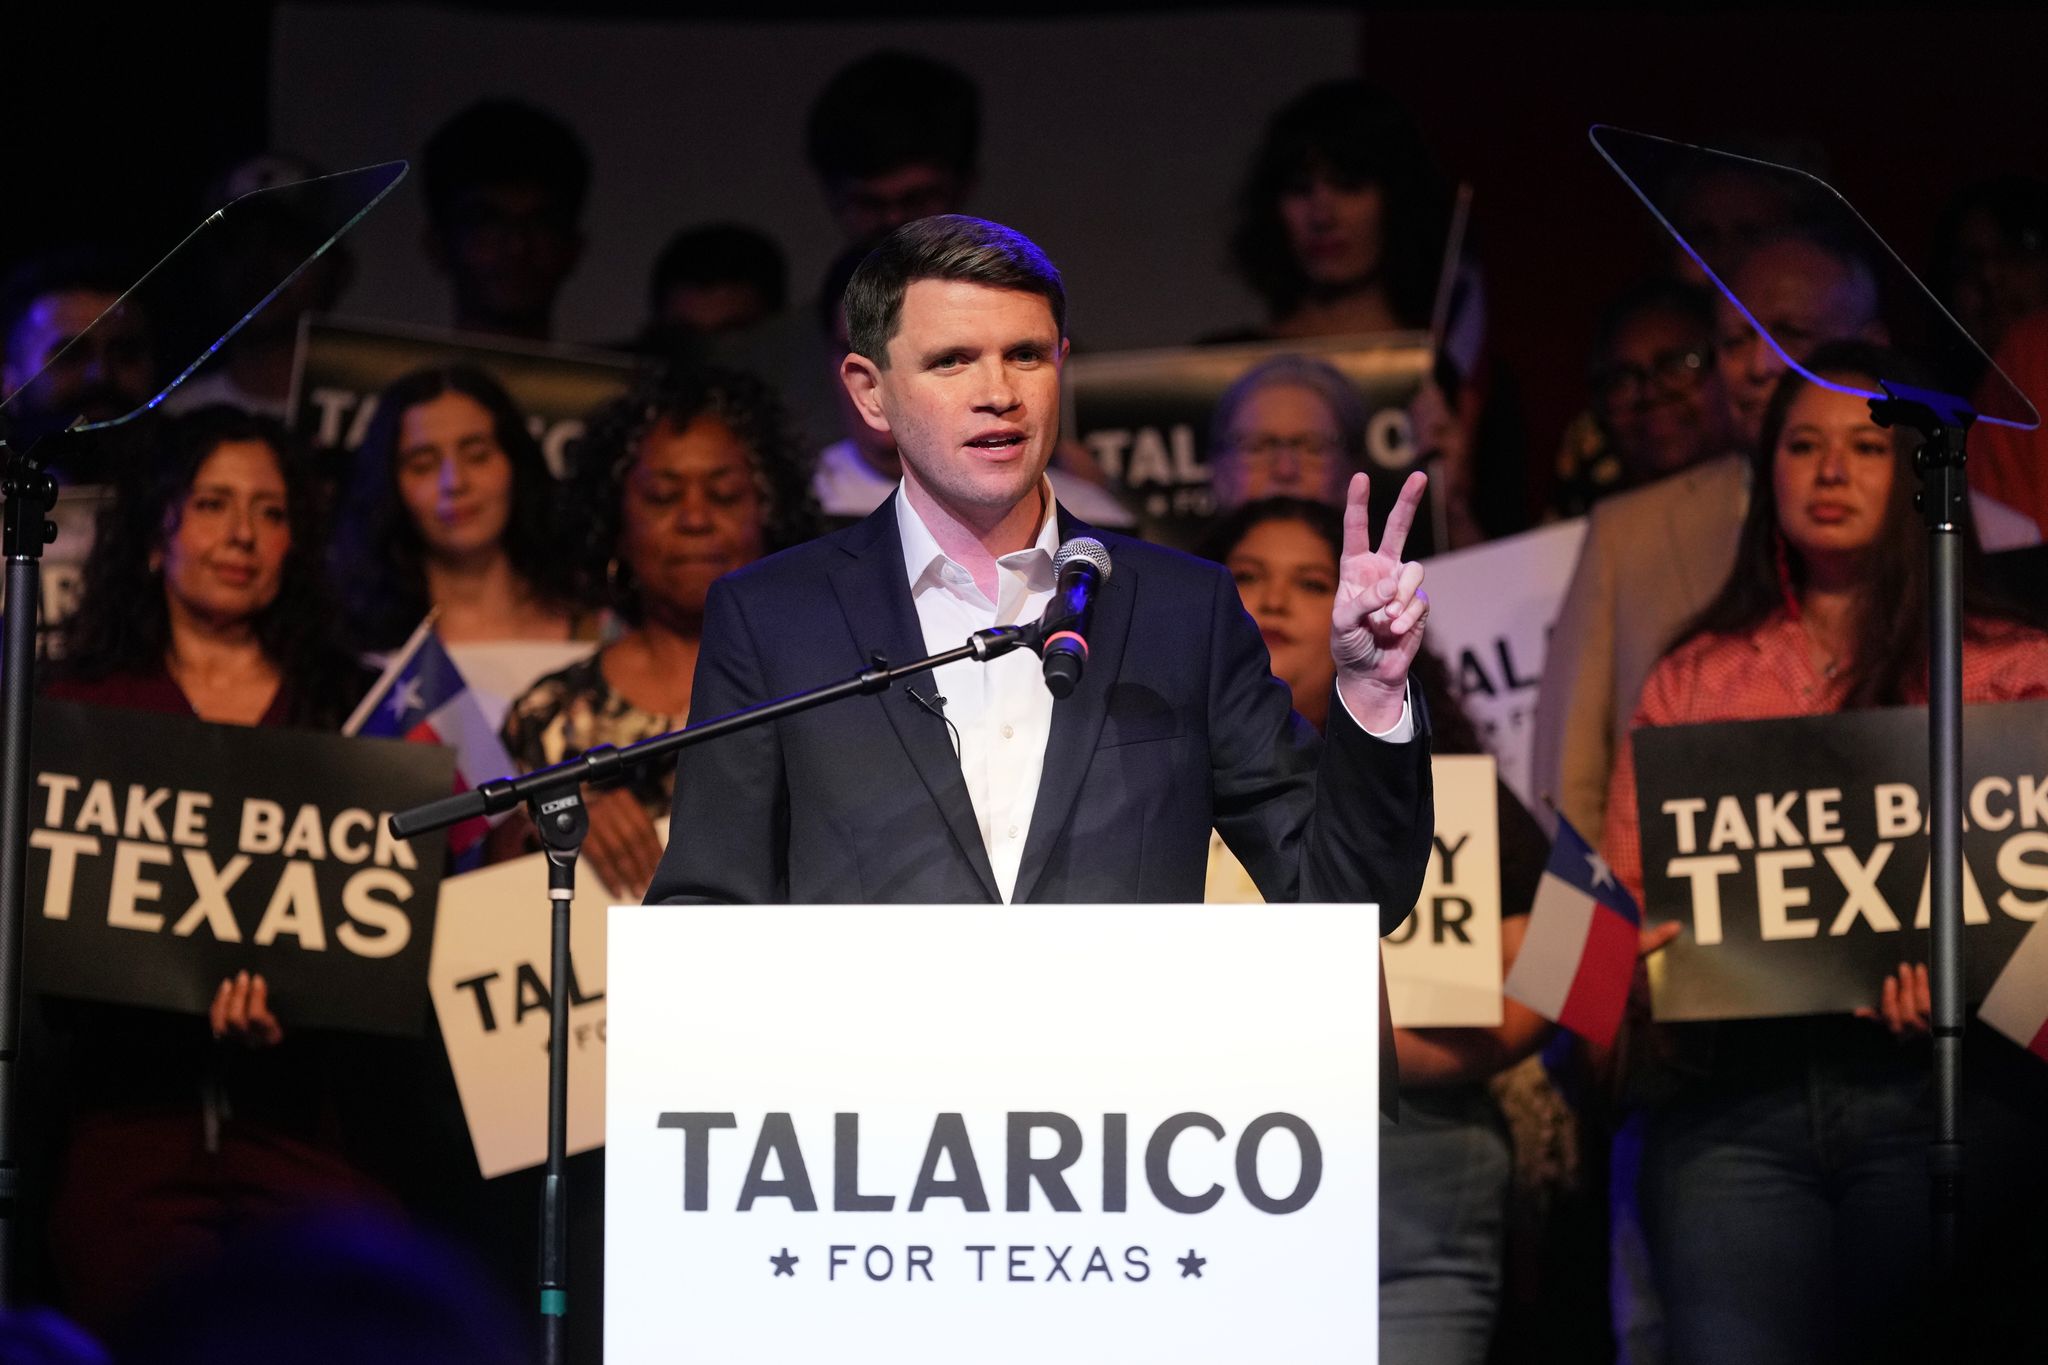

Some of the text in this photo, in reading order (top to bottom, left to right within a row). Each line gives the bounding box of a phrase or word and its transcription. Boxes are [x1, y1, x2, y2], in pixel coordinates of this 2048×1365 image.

[37, 771, 418, 870] TAKE BACK
[1661, 774, 2048, 854] TAKE BCK
[29, 827, 415, 959] TEXAS
[657, 1111, 1323, 1215] TALARICO
[829, 1244, 1151, 1283] FOR TEXAS
